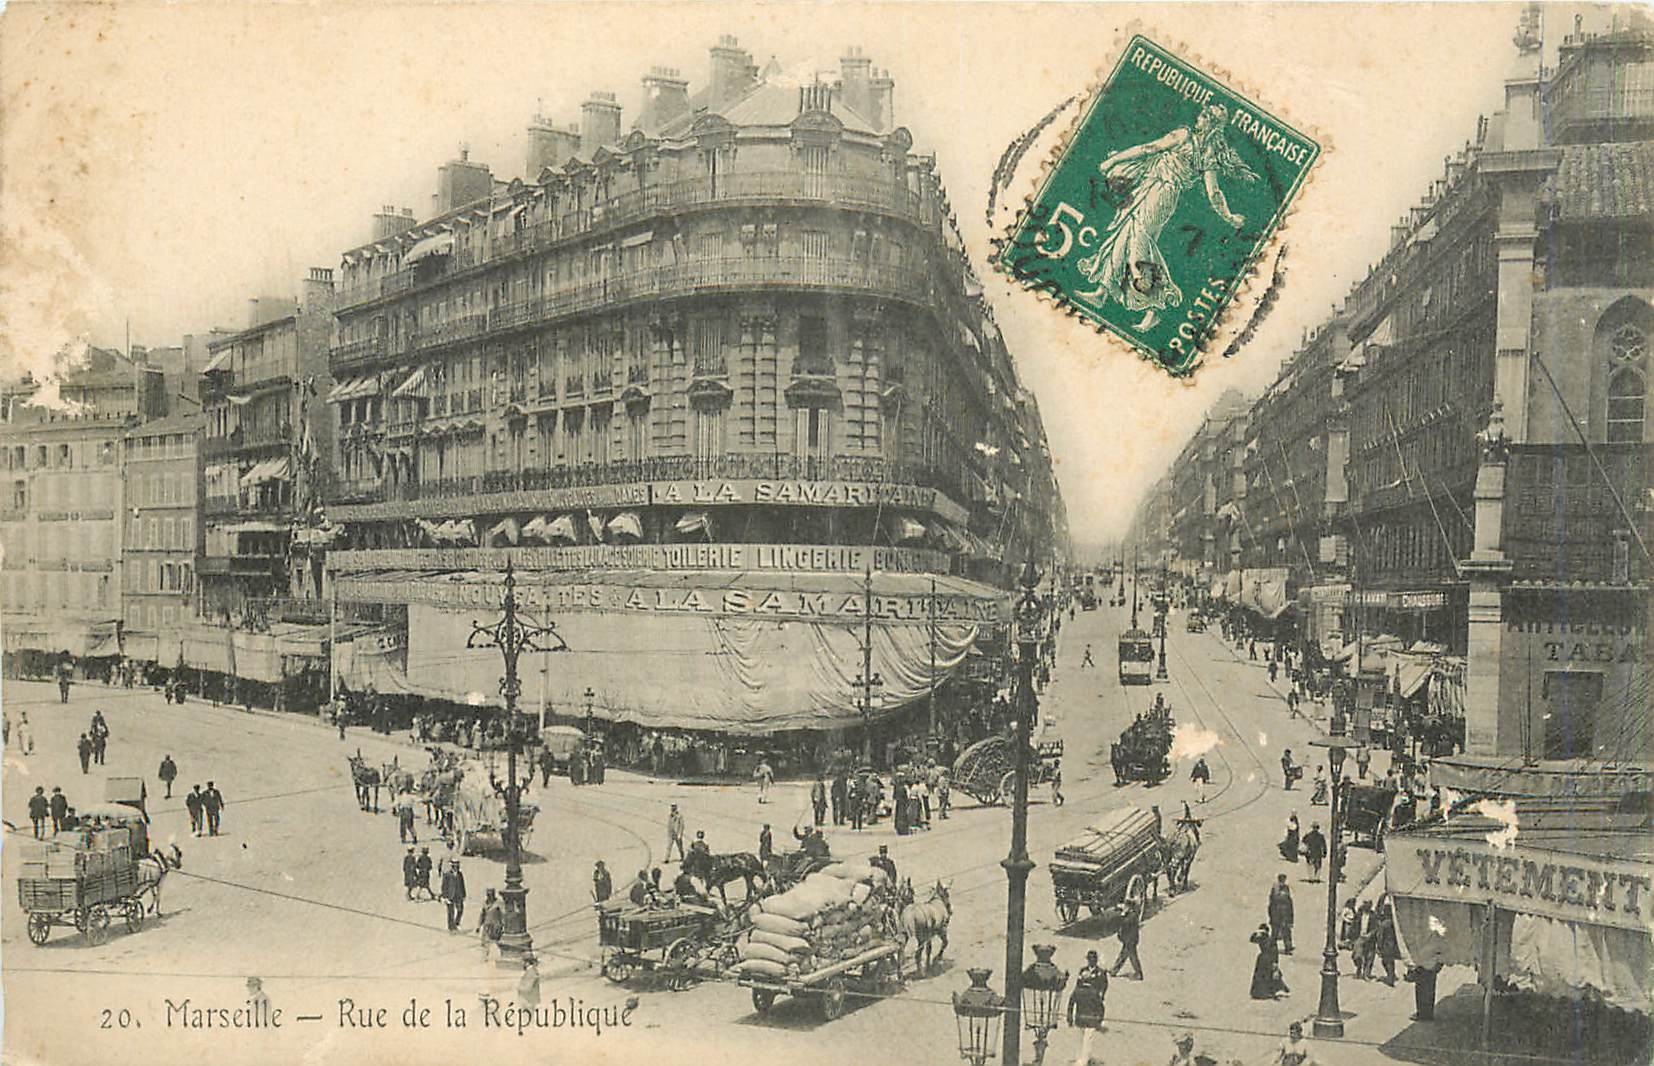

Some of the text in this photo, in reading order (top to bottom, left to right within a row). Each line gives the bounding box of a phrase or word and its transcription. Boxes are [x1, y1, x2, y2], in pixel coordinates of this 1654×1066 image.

[1231, 109, 1308, 166] FRANÇAISE
[1168, 277, 1225, 354] POSTES
[665, 480, 938, 508] A LA SAMARITAINE
[663, 545, 743, 569] TOILERIE
[757, 546, 862, 571] LINGERIE
[623, 588, 650, 612] A
[653, 589, 714, 613] LA
[722, 590, 999, 621] SAMARITAINE
